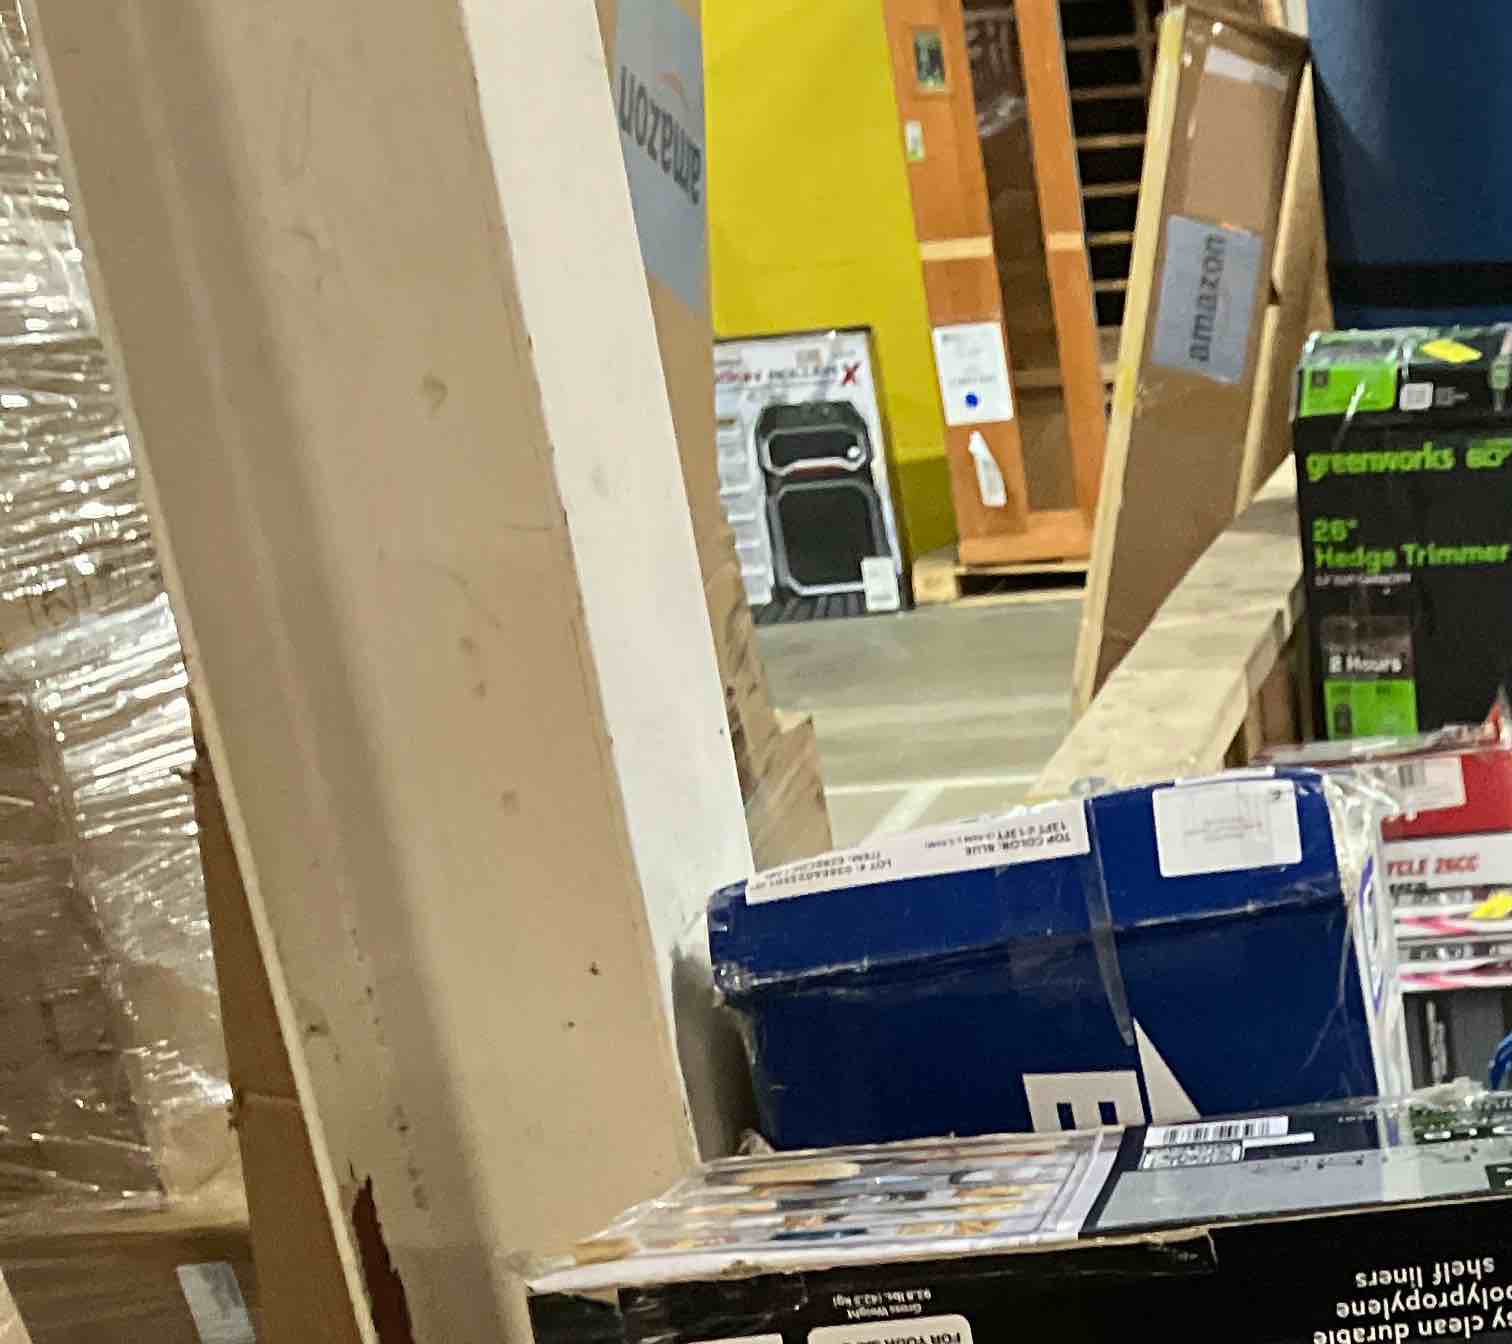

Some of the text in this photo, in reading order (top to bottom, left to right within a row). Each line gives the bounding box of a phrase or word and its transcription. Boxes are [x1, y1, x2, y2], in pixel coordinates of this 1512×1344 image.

[618, 65, 702, 207] amazon
[1189, 232, 1225, 363] amazon
[1306, 442, 1456, 482] greenworks
[1314, 541, 1511, 573] Hedge Trimmer
[1355, 1257, 1495, 1288] shelf liners
[1417, 1315, 1484, 1339] clean
